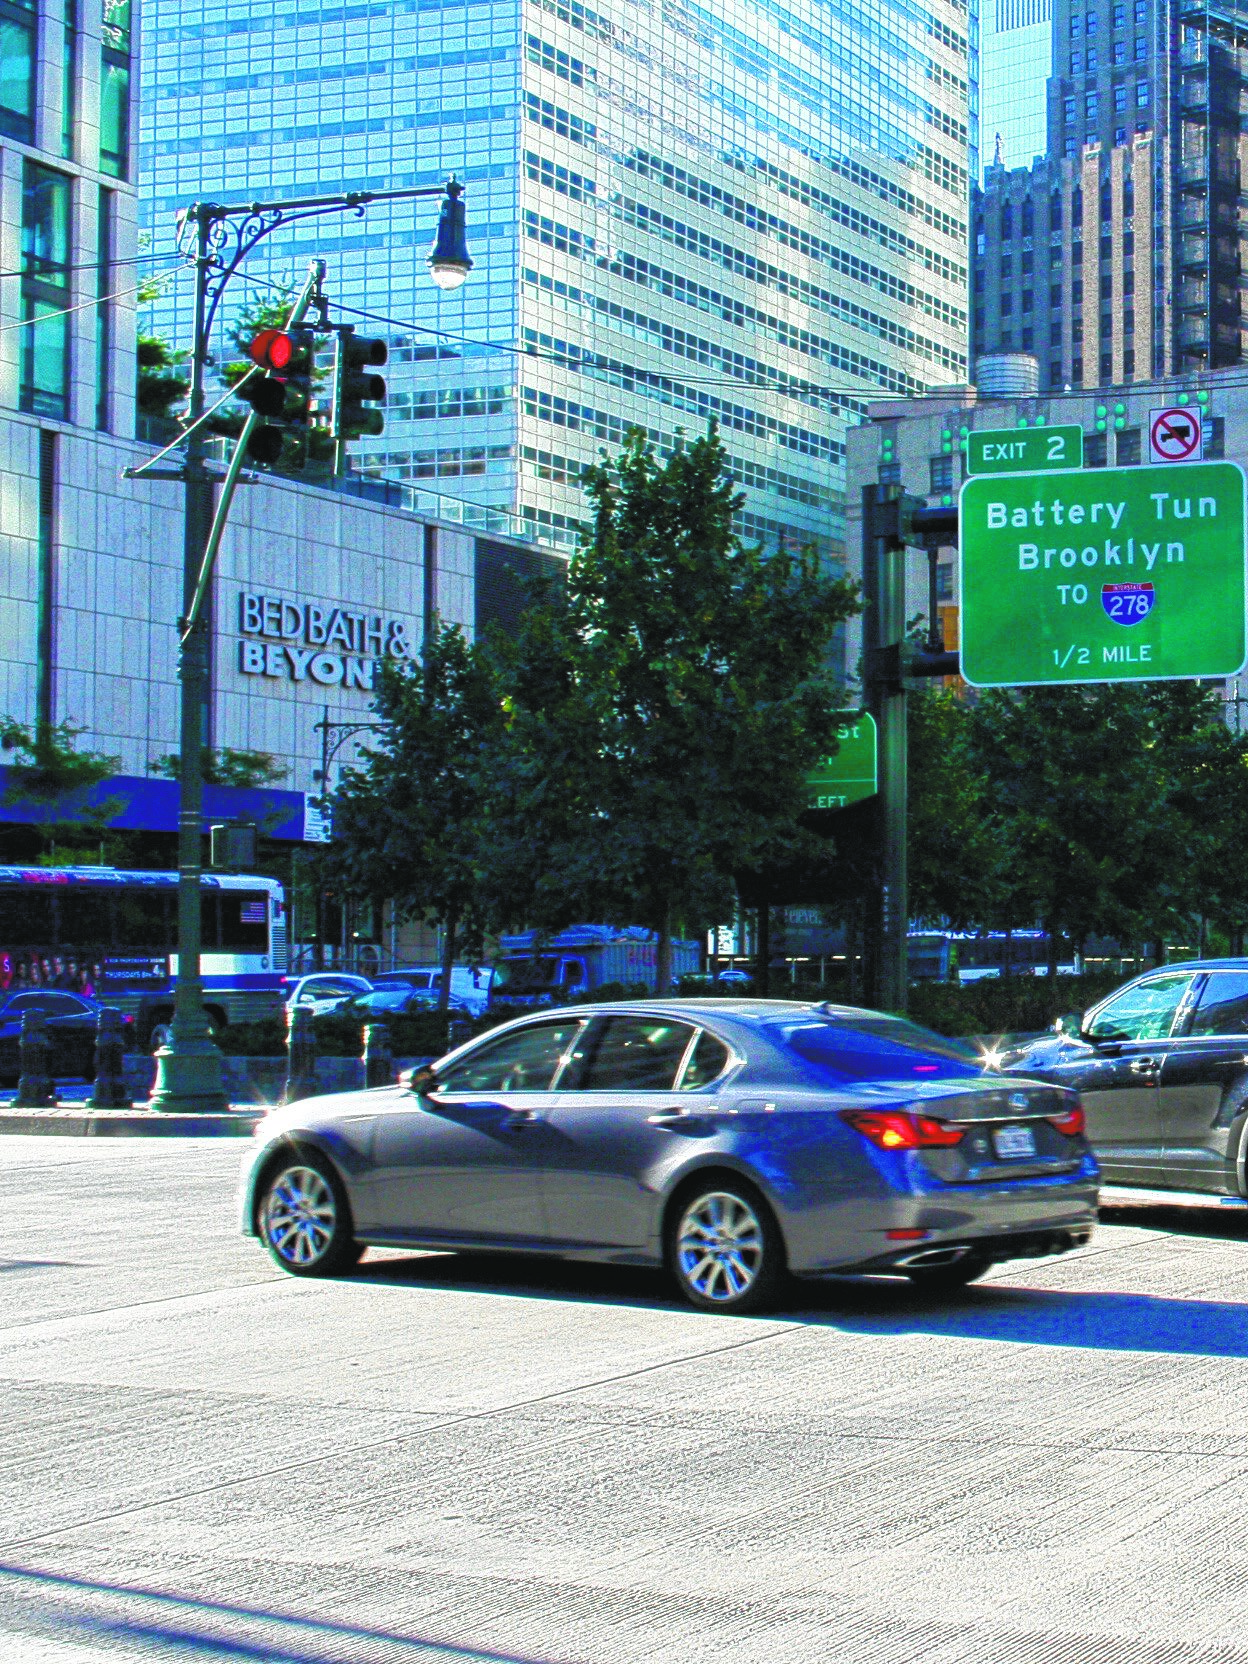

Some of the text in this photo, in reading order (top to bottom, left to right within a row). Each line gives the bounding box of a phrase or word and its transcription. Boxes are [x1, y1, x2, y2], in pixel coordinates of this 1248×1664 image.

[982, 436, 1066, 461] EXIT 2
[986, 492, 1218, 529] Battery Tun
[1018, 538, 1186, 571] Brooklyn
[1056, 584, 1150, 617] TO 278
[239, 591, 424, 667] BED BATH &
[239, 640, 391, 691] BEYON
[1052, 644, 1152, 669] 1/2 MILE
